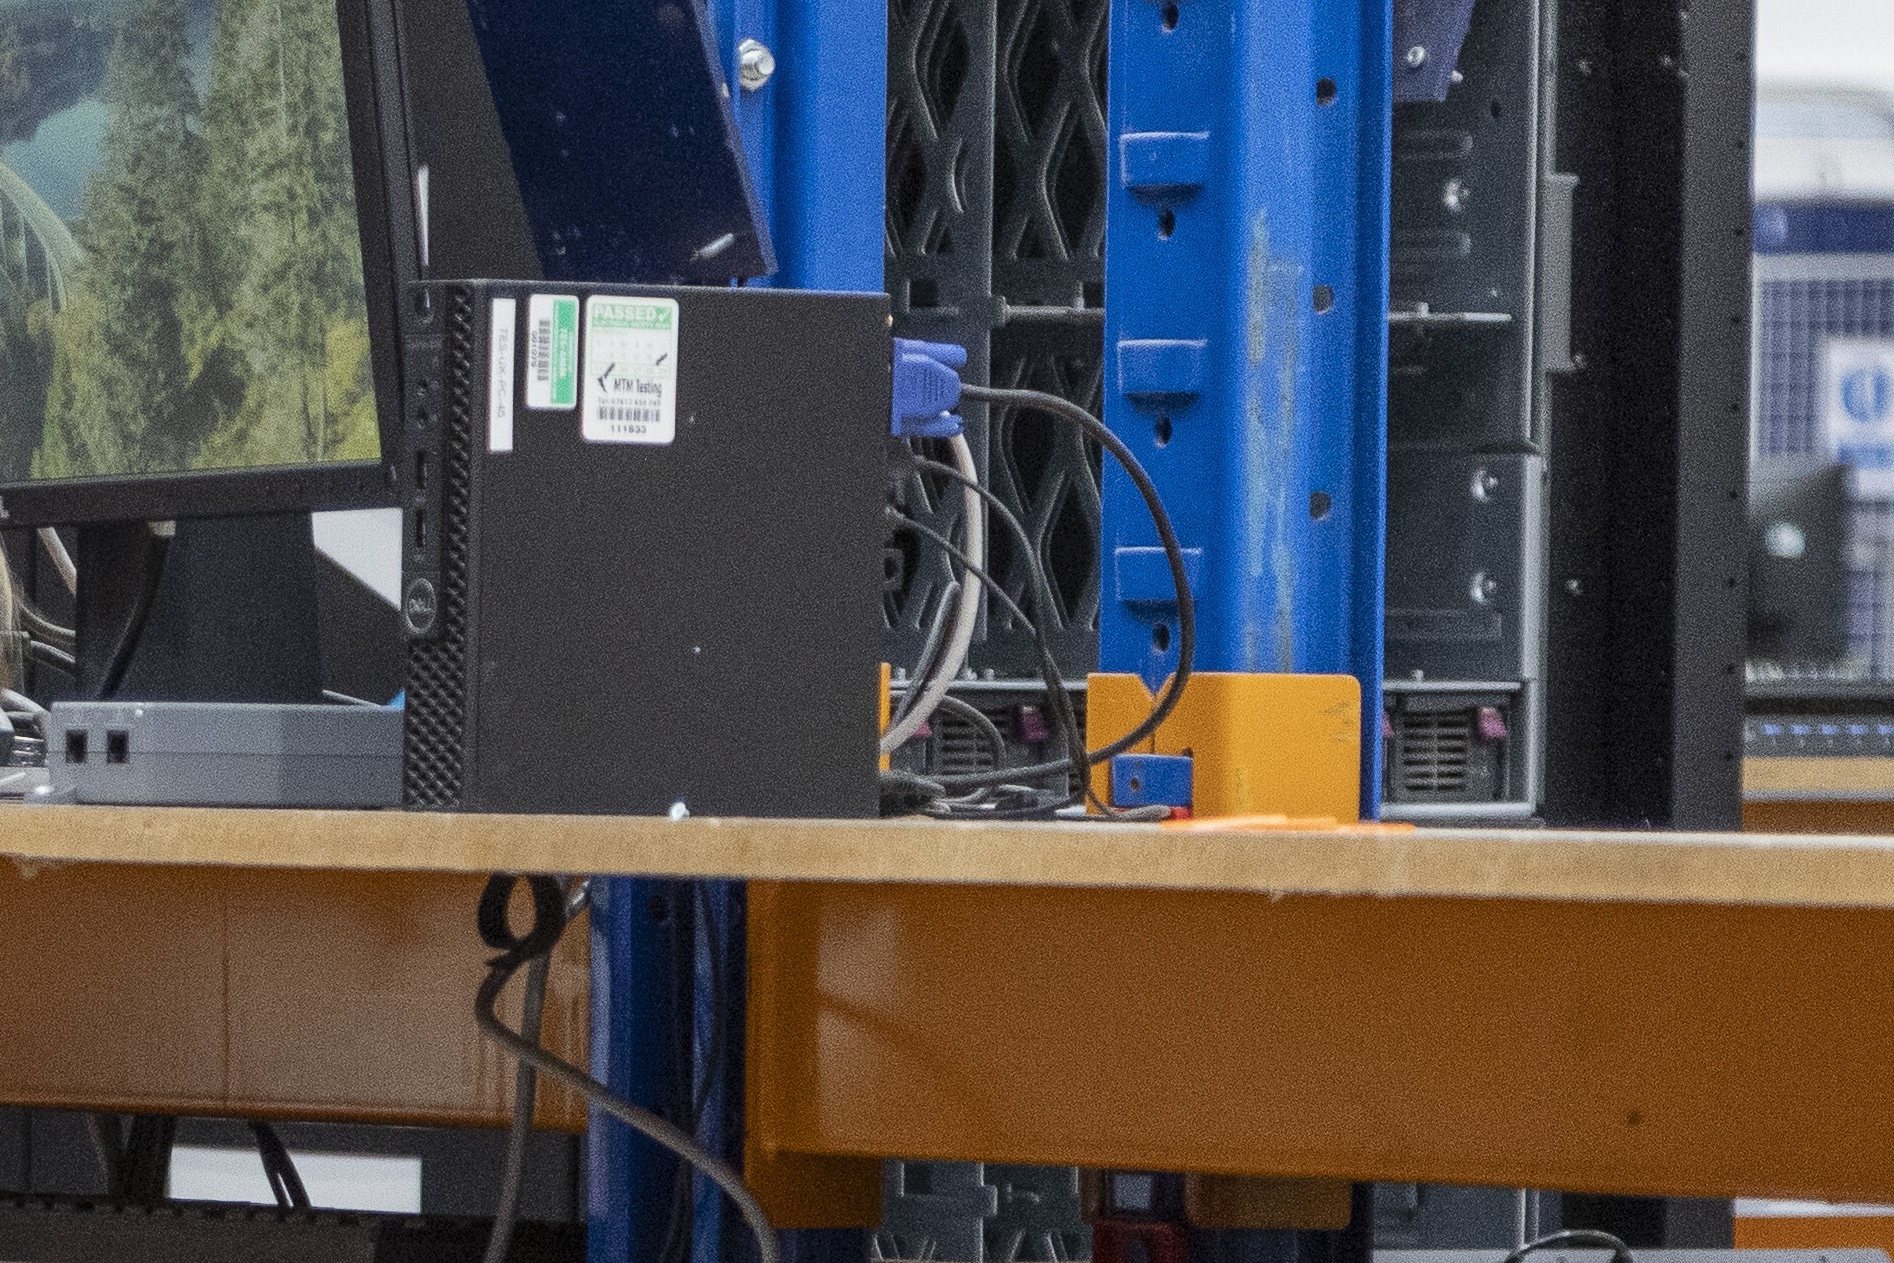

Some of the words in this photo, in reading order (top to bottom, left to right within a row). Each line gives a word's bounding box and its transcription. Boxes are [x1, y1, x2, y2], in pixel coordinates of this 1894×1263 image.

[594, 305, 657, 321] PASSED
[614, 379, 633, 393] MTM
[636, 379, 662, 398] Testing
